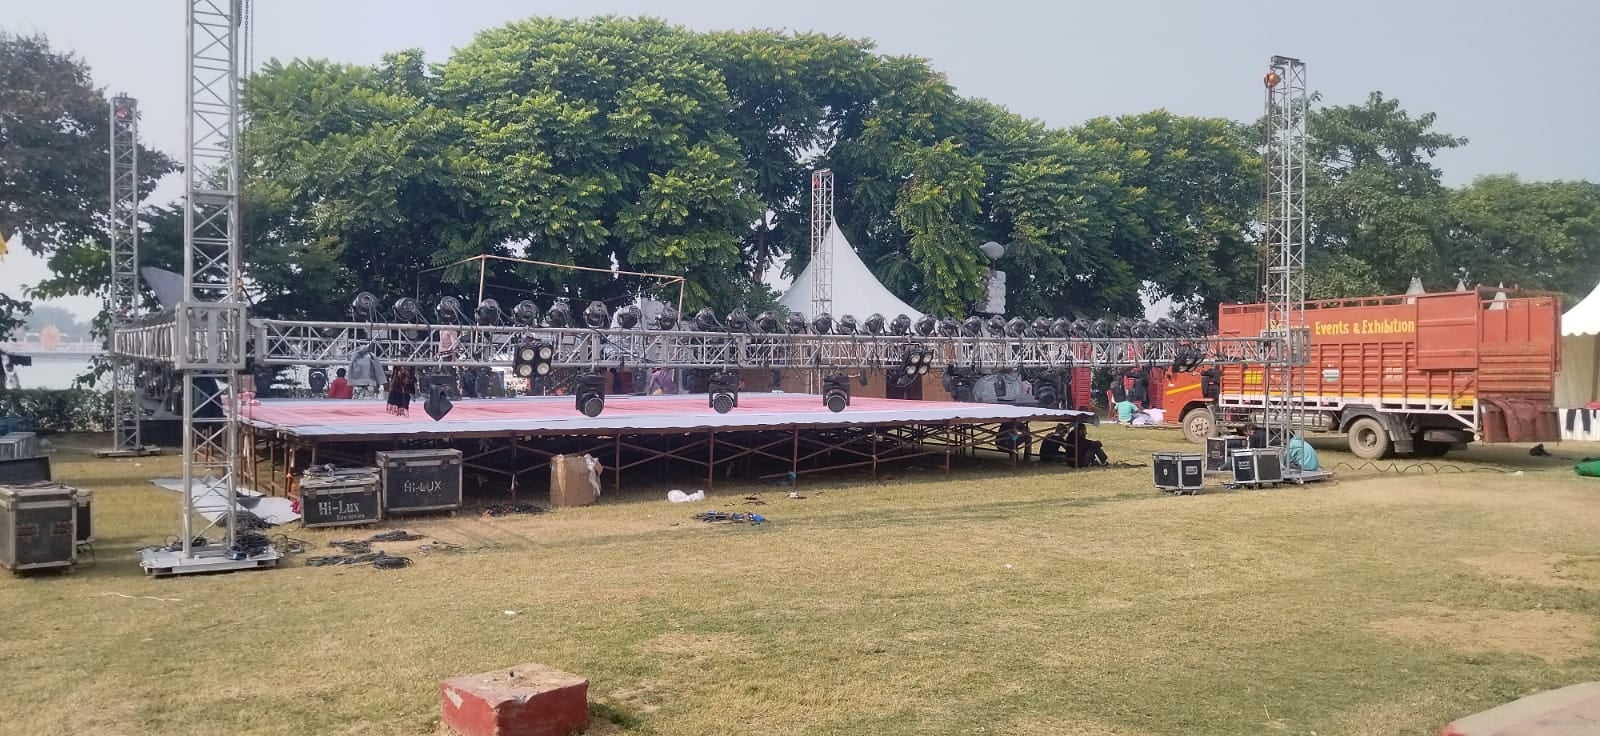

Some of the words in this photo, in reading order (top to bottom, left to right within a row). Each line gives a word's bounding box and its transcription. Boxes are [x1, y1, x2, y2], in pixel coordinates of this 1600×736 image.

[1315, 321, 1349, 335] Events
[1362, 318, 1415, 334] Exhibition
[318, 501, 360, 515] Hi-Lux
